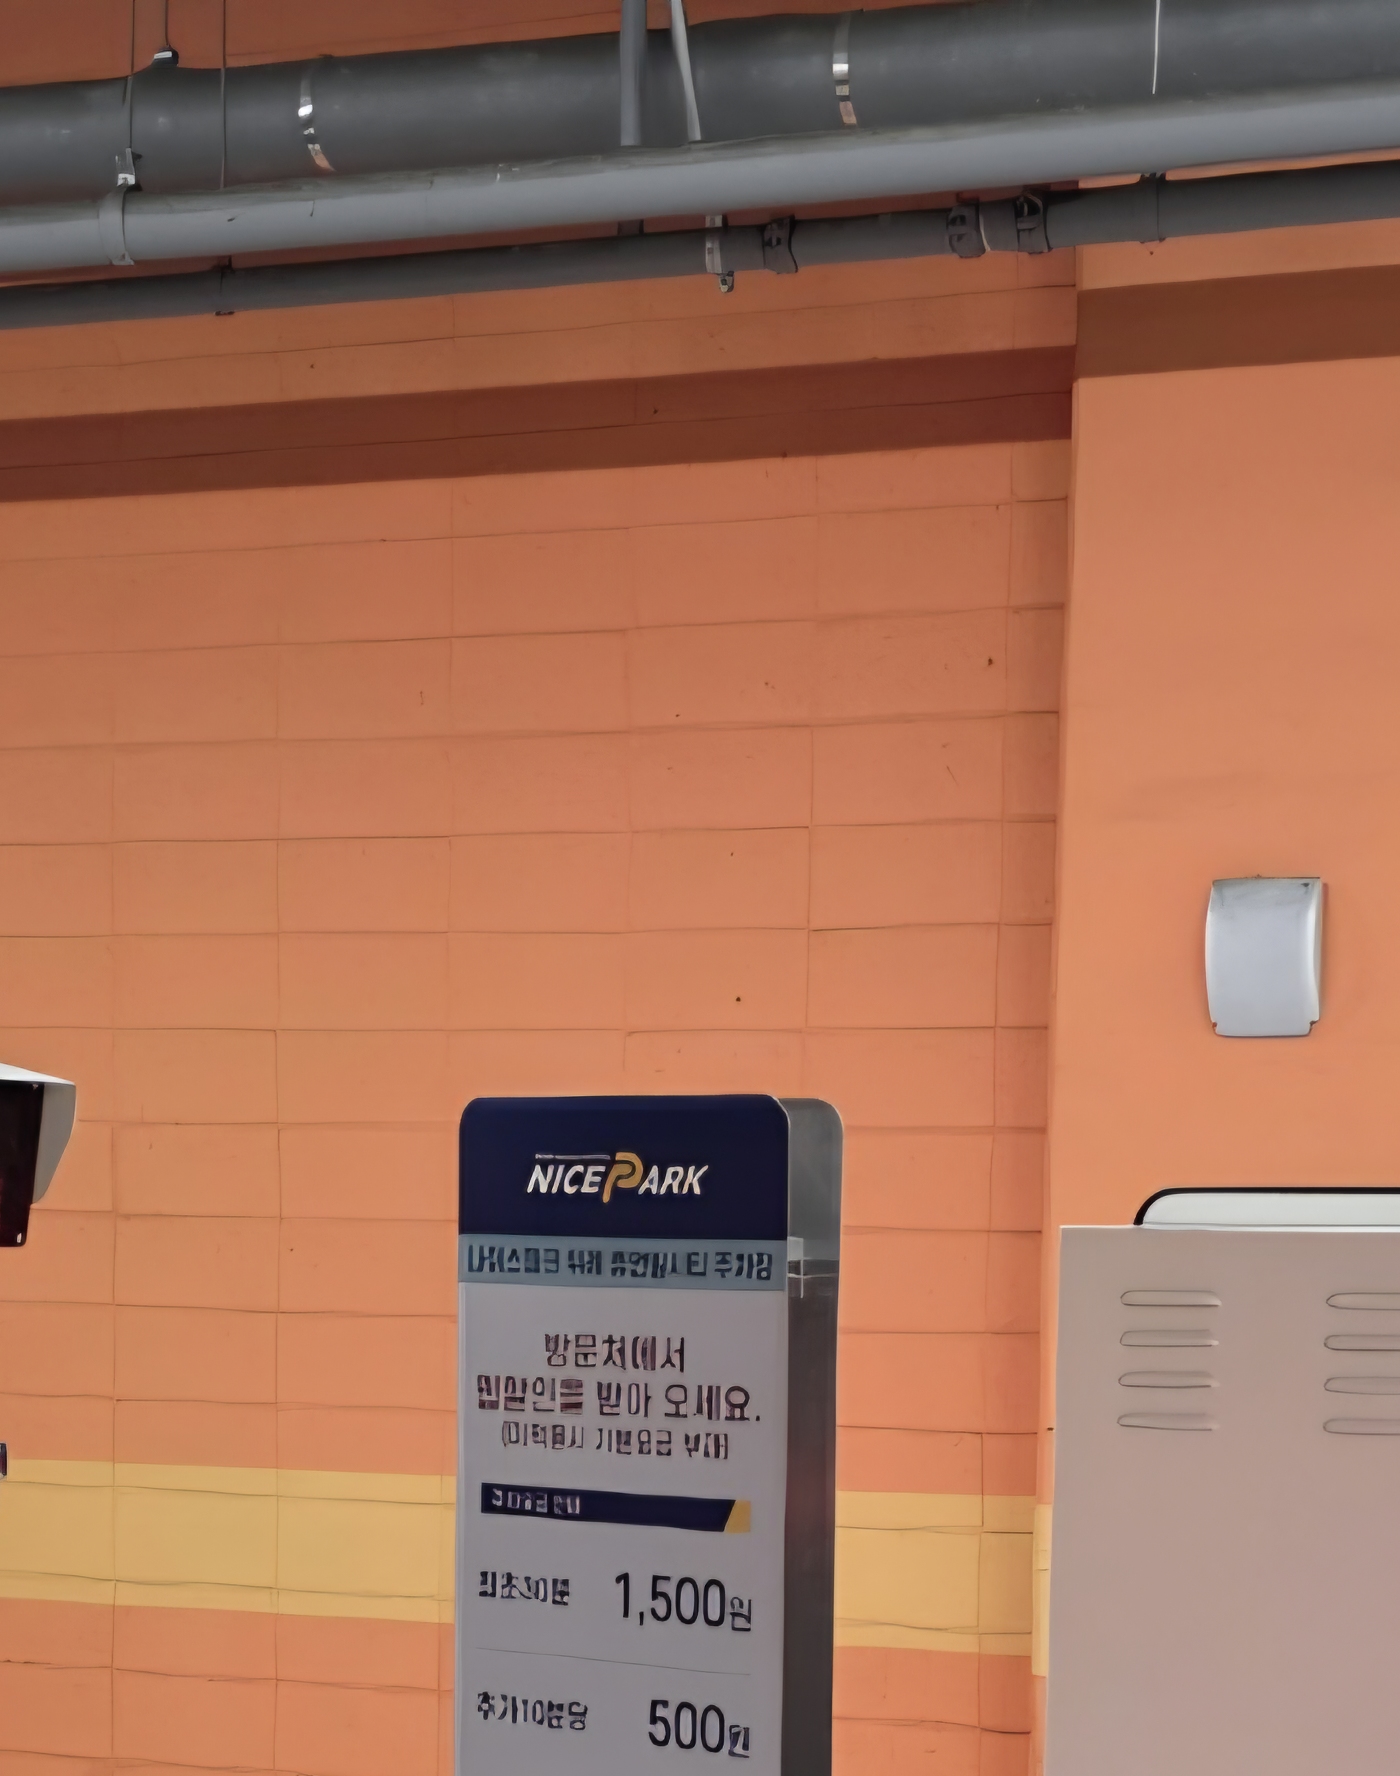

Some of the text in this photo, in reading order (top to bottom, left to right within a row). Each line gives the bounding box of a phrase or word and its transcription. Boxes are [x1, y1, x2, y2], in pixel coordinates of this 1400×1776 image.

[526, 1152, 709, 1204] NICEPARK
[596, 1380, 652, 1418] 받아
[664, 1383, 761, 1421] 오세요.
[614, 1571, 752, 1632] 1,500원
[647, 1699, 751, 1758] 500원
